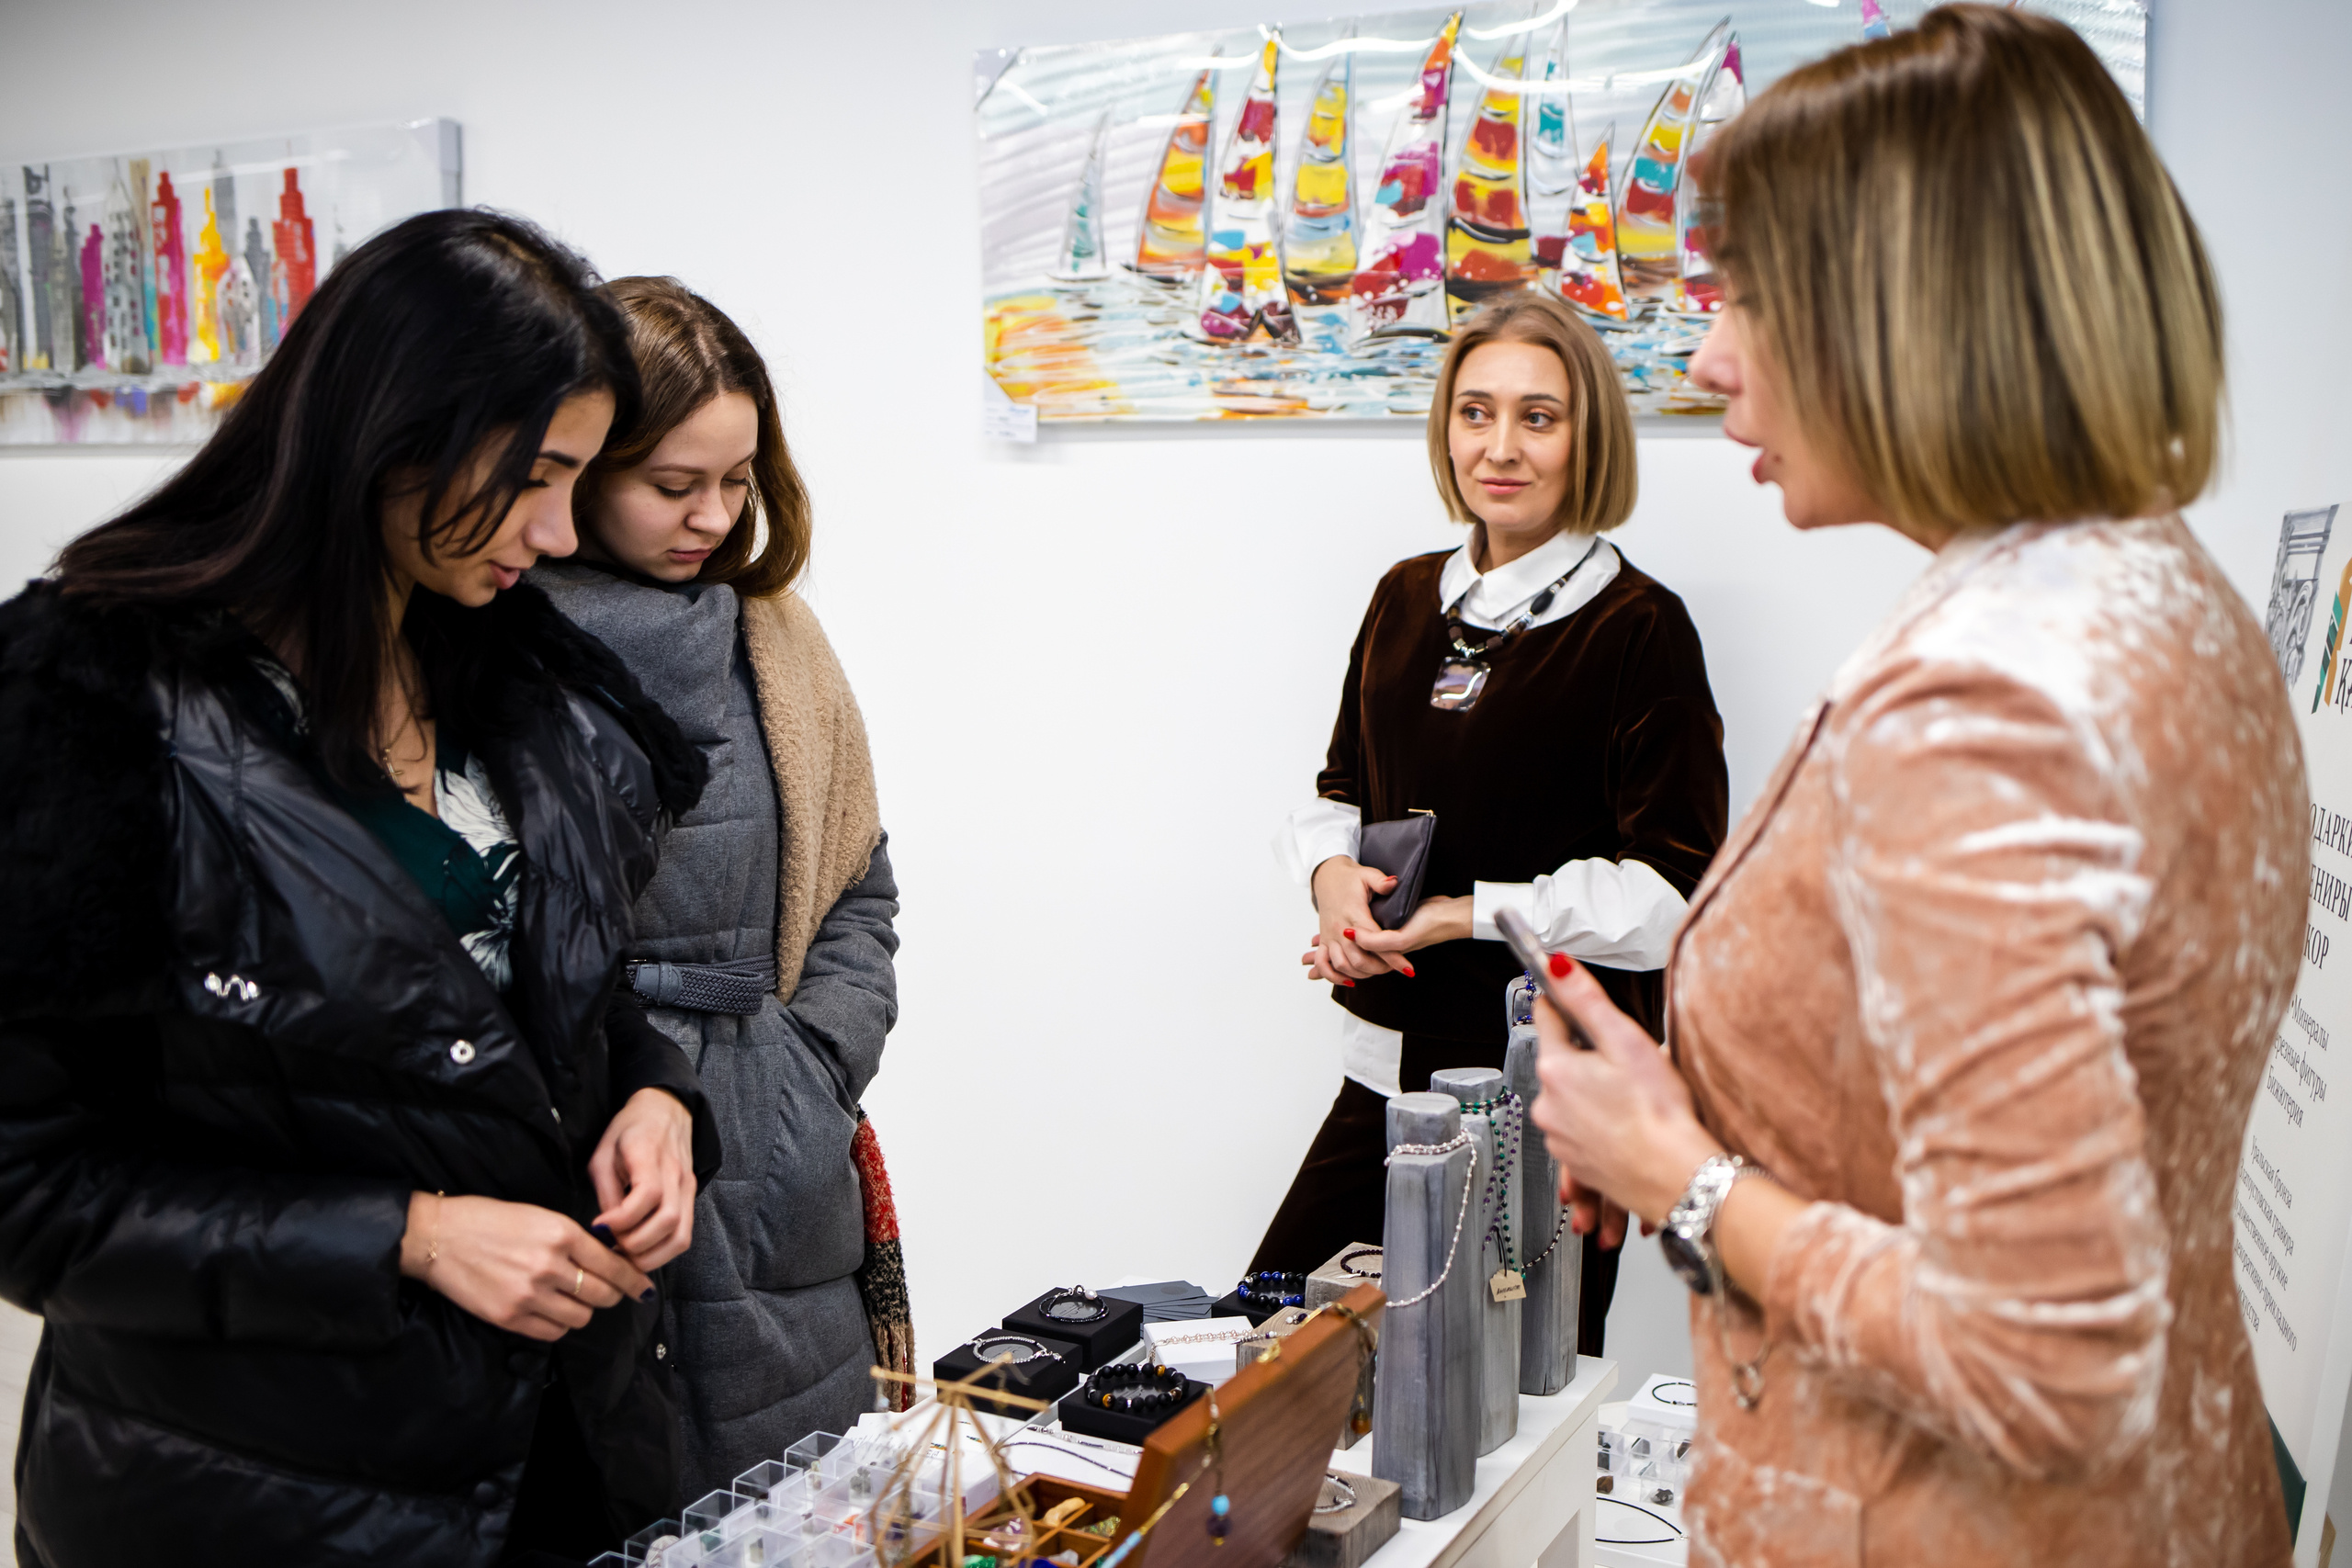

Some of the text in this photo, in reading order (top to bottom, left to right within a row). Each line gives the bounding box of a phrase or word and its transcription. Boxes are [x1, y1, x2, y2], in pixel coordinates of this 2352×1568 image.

[2299, 1051, 2327, 1102] фигуры
[2251, 1134, 2292, 1210] Уральская бронза
[2272, 1213, 2294, 1257] гравюра
[2267, 1251, 2289, 1292] оружие
